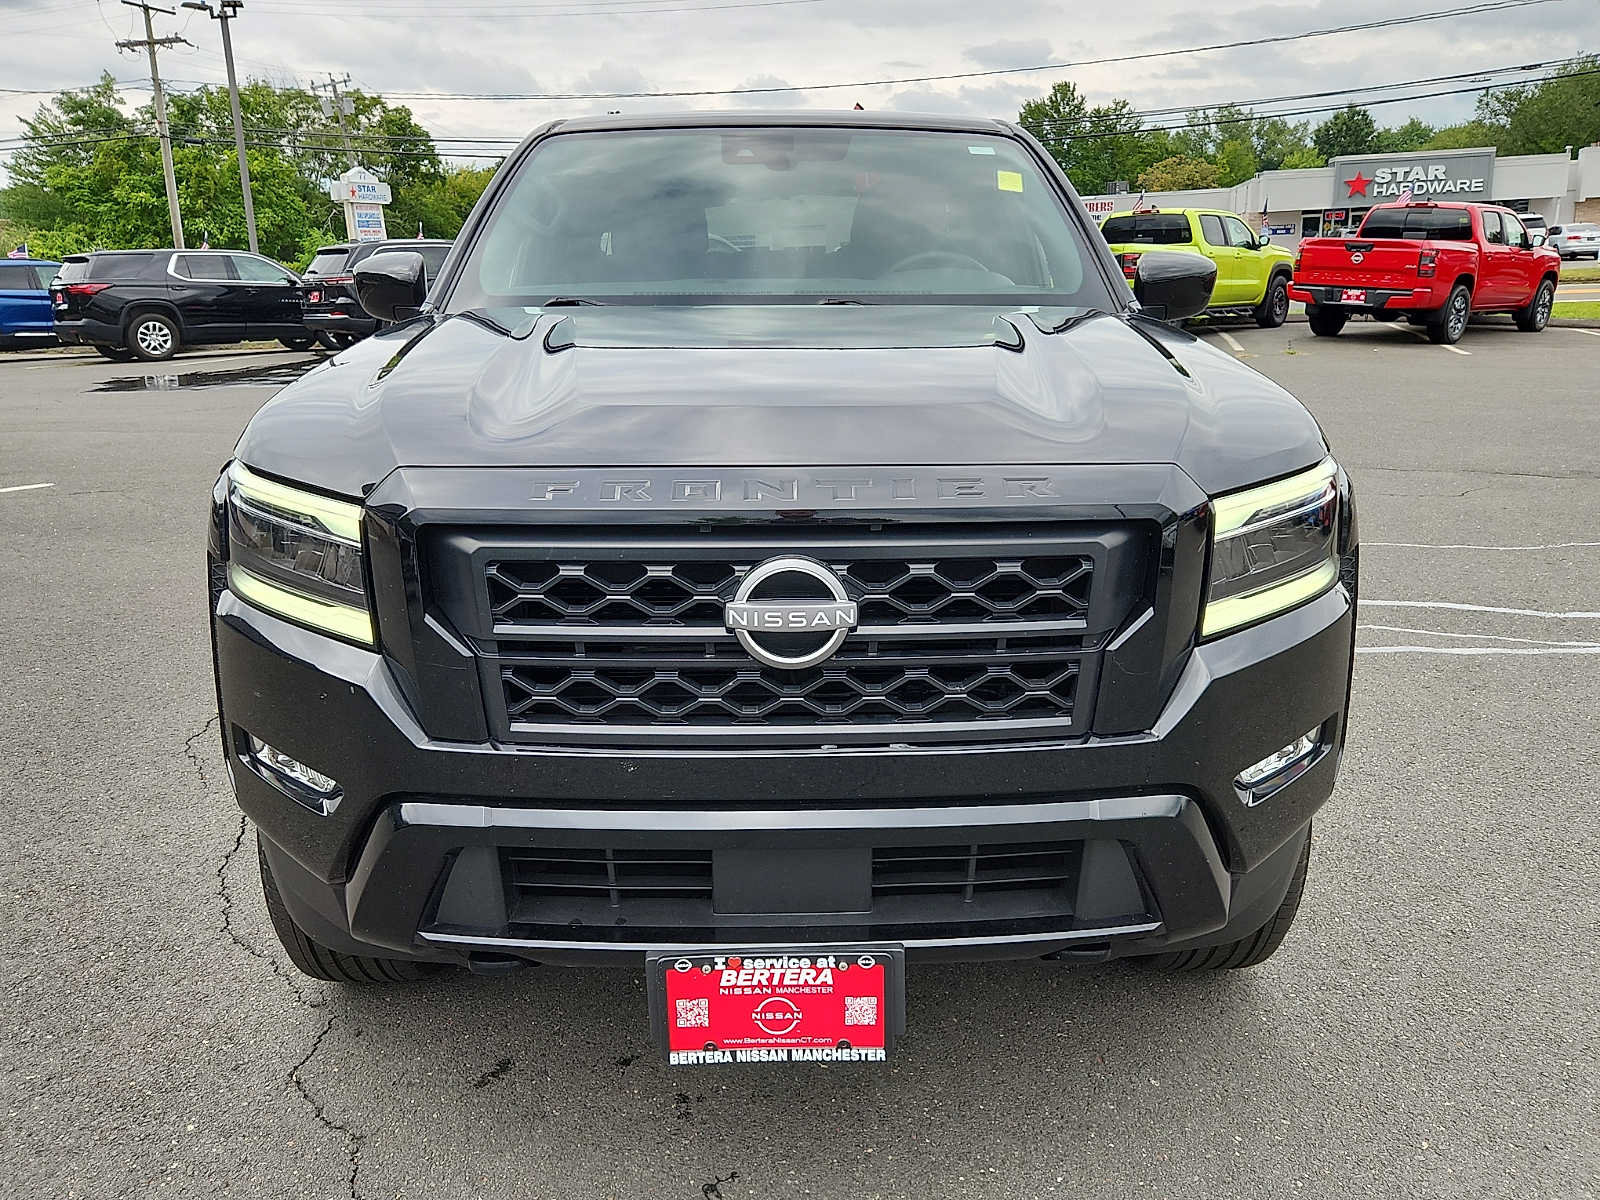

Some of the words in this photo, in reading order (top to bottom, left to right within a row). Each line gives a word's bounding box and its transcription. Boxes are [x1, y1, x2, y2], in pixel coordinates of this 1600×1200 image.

[1375, 164, 1446, 184] STAR
[357, 184, 376, 193] STAR
[528, 477, 1062, 502] FRONTIER
[728, 608, 856, 628] NISSAN
[714, 957, 726, 970] I
[743, 956, 812, 969] service
[816, 955, 836, 969] at
[720, 968, 834, 986] BERTERA
[719, 987, 772, 995] NISSAN
[775, 986, 834, 994] MANCHESTER
[751, 1012, 803, 1020] NISSAN
[722, 1037, 833, 1045] www.BerteraNissanCT.com
[669, 1050, 733, 1065] BERTERA
[736, 1049, 788, 1063] NISSAN
[791, 1048, 886, 1062] MANCHESTER
